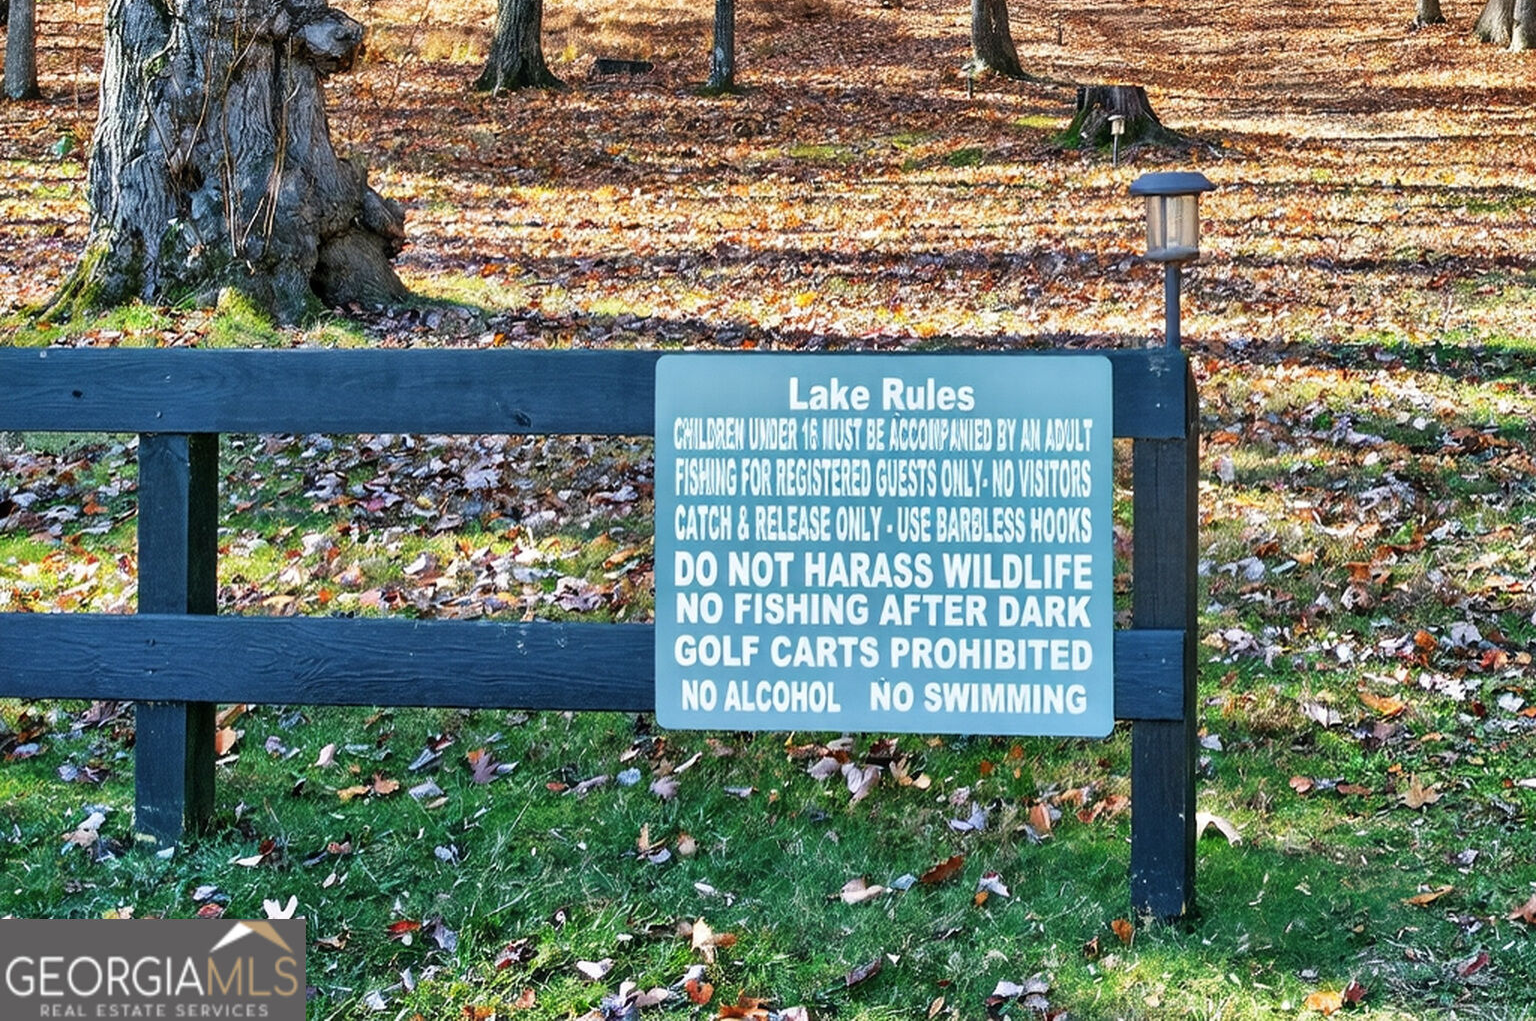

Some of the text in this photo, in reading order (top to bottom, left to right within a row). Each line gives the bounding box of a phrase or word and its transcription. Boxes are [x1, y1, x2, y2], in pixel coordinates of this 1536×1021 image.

[789, 376, 975, 411] Lake Rules
[674, 417, 1093, 452] CHILDREN UNDER 16 MUST BE ACCOMPANIED BY AN ADULT
[675, 459, 736, 496] FISHING
[741, 459, 771, 496] FOR
[776, 459, 870, 496] REGISTERED
[876, 459, 936, 498] GUESTS
[993, 460, 1013, 498] NO
[1019, 460, 1091, 498] VISITORS
[674, 506, 732, 541] CATCH
[738, 506, 749, 541] &
[755, 506, 831, 542] RELEASE
[836, 506, 882, 542] ONLY
[898, 507, 931, 542] USE
[937, 507, 1025, 543] BARBLESS
[1031, 508, 1092, 543] HOOKS
[674, 551, 1093, 590] DO NOT HARASS WILDLIFE
[676, 593, 1092, 627] NO FISHING AFTER DARK
[674, 635, 1093, 670] GOLF CARTS PROHIBITED
[682, 680, 1087, 714] NO ALCOHOL NO SWIMMING
